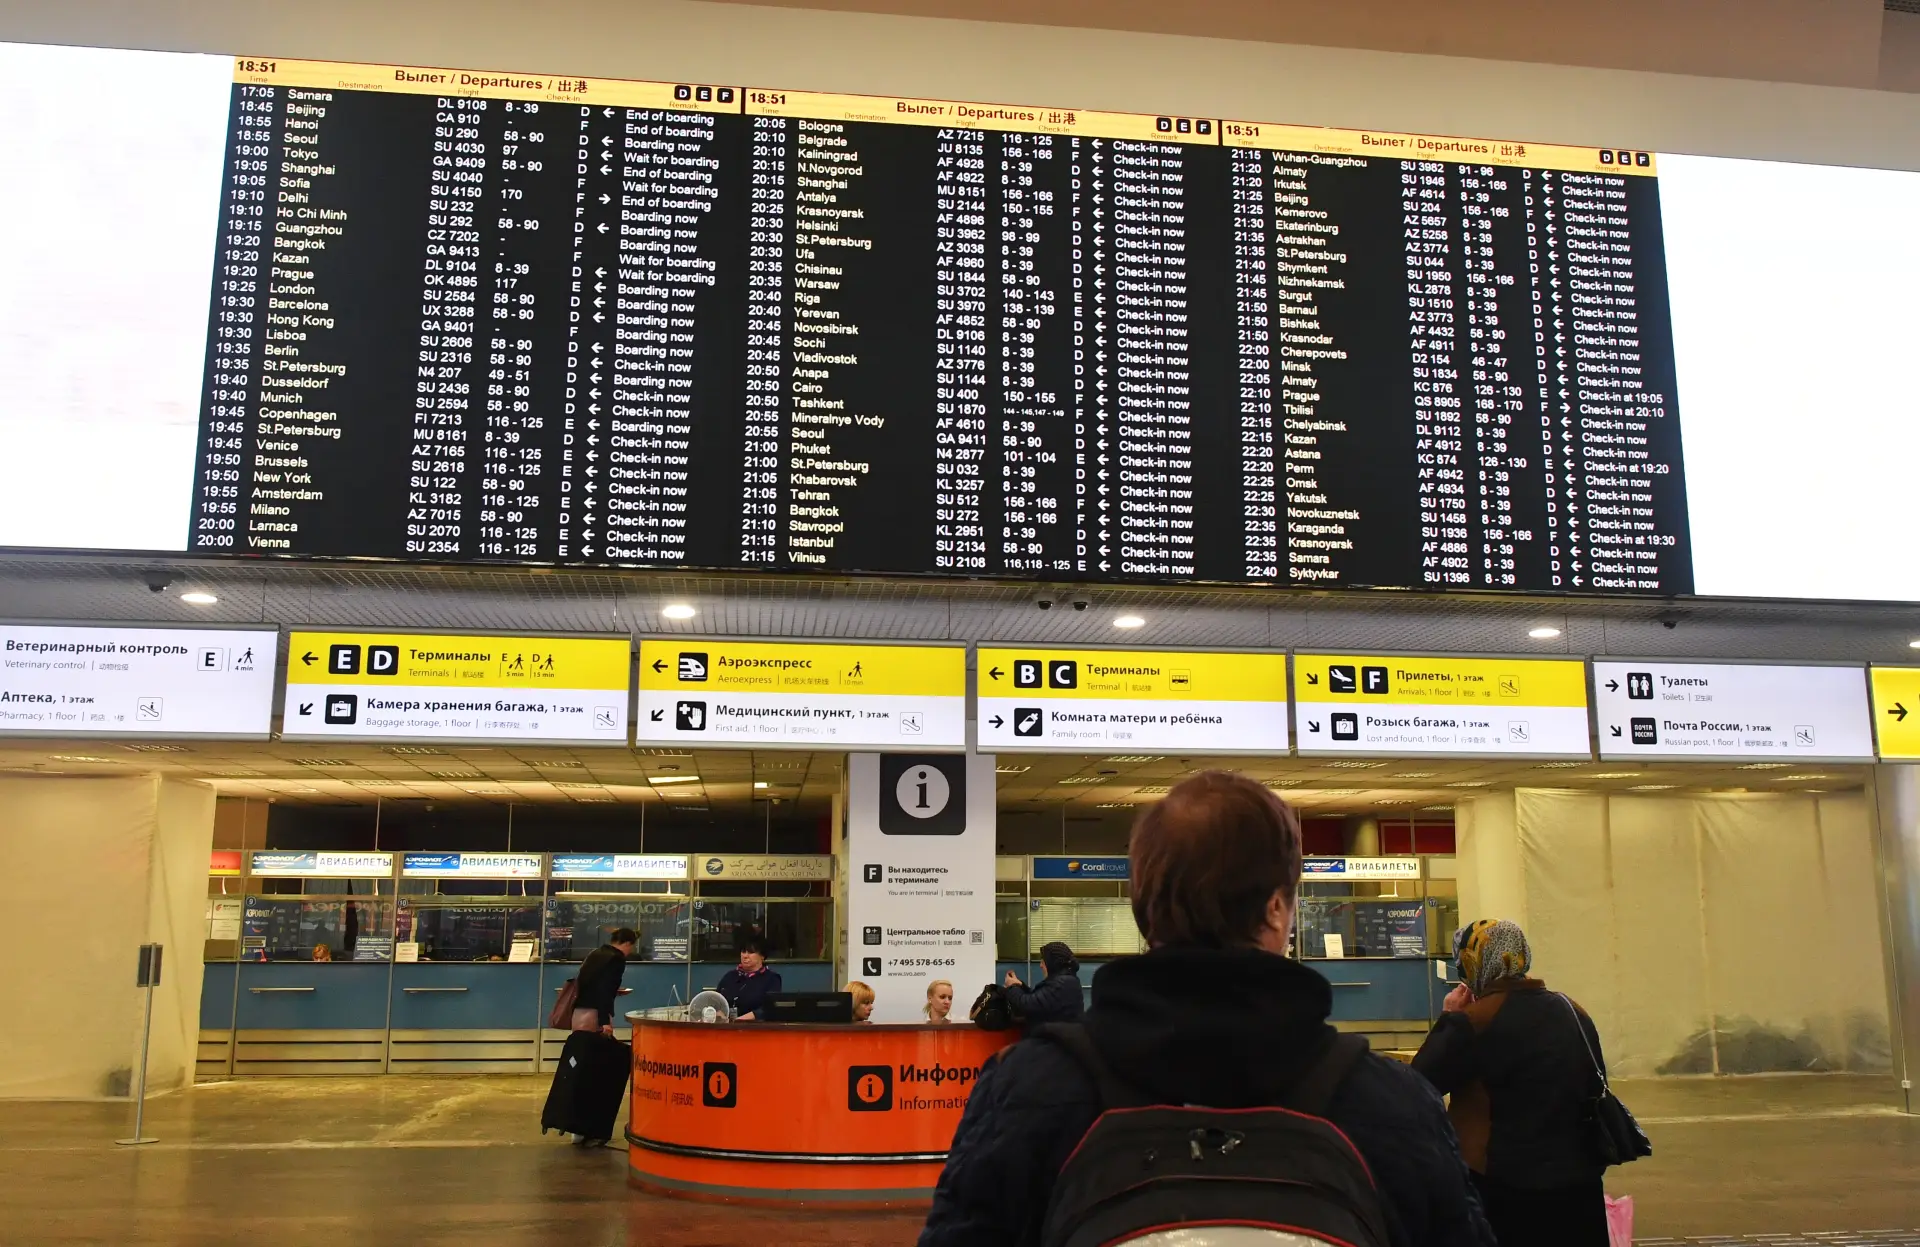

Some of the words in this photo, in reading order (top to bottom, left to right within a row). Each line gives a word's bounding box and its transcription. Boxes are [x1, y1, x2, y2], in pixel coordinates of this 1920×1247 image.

[237, 60, 276, 73] 18:51
[250, 75, 268, 83] Time
[337, 80, 383, 90] Destination
[395, 70, 446, 83] Вылет
[460, 74, 543, 89] Departures
[558, 79, 588, 94] 出港
[241, 86, 275, 98] 17:05
[288, 88, 333, 101] Samara
[750, 92, 786, 105] 18:51
[240, 101, 273, 113] 18:45
[286, 103, 326, 118] Beijing
[753, 117, 786, 129] 20:05
[798, 120, 844, 134] Bologna
[937, 129, 954, 140] AZ
[956, 130, 985, 142] 7215
[1417, 138, 1488, 153] Departures
[1231, 148, 1261, 160] 21:15
[1272, 151, 1367, 168] Wuhan-Guangzhou
[229, 204, 263, 216] 19:10
[276, 206, 294, 218] Ho
[297, 207, 317, 219] Chi
[320, 208, 347, 221] Minh
[750, 231, 783, 243] 20:30
[795, 233, 872, 250] St.Petersburg
[210, 405, 245, 417] 19:45
[259, 407, 337, 423] Copenhagen
[1240, 401, 1272, 414] 22:10
[1282, 403, 1314, 415] Tbilisi
[745, 410, 779, 422] 20:55
[791, 411, 852, 427] Mineralnye
[854, 414, 885, 429] Vody
[197, 534, 234, 547] 20:00
[248, 536, 290, 548] Vienna
[406, 540, 425, 552] SU
[427, 541, 460, 553] 2354
[605, 546, 658, 559] Check-in
[660, 550, 685, 559] now
[741, 550, 775, 562] 21:15
[788, 551, 826, 564] Vilnius
[1246, 565, 1278, 577] 22:40
[1289, 567, 1339, 581] Syktyvkar
[6, 639, 116, 655] Ветеринарный
[119, 645, 188, 657] контроль
[205, 652, 216, 667] E
[337, 649, 352, 669] E
[373, 650, 392, 670] D
[409, 649, 491, 663] Терминалы
[4, 659, 51, 671] Veterinary
[53, 661, 86, 670] control
[718, 656, 812, 671] Аэроэкспресс
[408, 668, 450, 677] Terminals
[1021, 664, 1035, 684] B
[1055, 665, 1070, 684] C
[1086, 664, 1160, 677] Терминалы
[1396, 670, 1454, 683] Прилеты,
[717, 674, 772, 685] Aeroexpress
[1369, 671, 1381, 689] F
[1660, 675, 1708, 688] Туалеты
[1086, 682, 1120, 691] Terminal
[1397, 687, 1427, 696] Arrivals,
[1434, 687, 1452, 696] floor
[0, 691, 56, 704] Аптека,
[1662, 693, 1685, 701] Toilets
[367, 698, 420, 712] Камера
[424, 702, 491, 713] хранения
[495, 700, 548, 714] багажа,
[716, 705, 810, 718] Медицинский
[813, 709, 855, 720] пункт,
[0, 711, 45, 722] Pharmacy,
[55, 711, 77, 721] floor
[366, 717, 405, 728] Baggage
[407, 719, 441, 729] storage,
[451, 719, 472, 728] floor
[1051, 711, 1106, 722] Комната
[1110, 715, 1156, 726] матери
[1159, 715, 1167, 723] и
[1170, 713, 1222, 726] ребёнка
[1366, 716, 1411, 727] Розыск
[1413, 716, 1459, 728] багажа,
[715, 723, 733, 732] First
[735, 724, 751, 734] aid,
[759, 724, 778, 733] floor
[1663, 720, 1698, 731] Почта
[1700, 721, 1743, 732] России,
[1051, 729, 1078, 740] Family
[1366, 734, 1382, 742] Lost
[1384, 735, 1399, 743] and
[1400, 734, 1425, 743] found,
[1432, 734, 1450, 743] floor
[1664, 738, 1692, 746] Russian
[1693, 739, 1711, 747] post,
[1717, 738, 1734, 746] floor
[318, 856, 393, 868] АВИАБИЛЕТЫ
[460, 856, 541, 868] АВИАБИЛЕТЫ
[615, 859, 687, 870] АВИАБИЛЕТЫ
[1348, 862, 1417, 871] АВИАБИЛЕТЫ
[869, 867, 877, 880] F
[888, 866, 901, 874] Вы
[894, 877, 939, 885] терминале
[886, 928, 941, 937] Центральное
[942, 927, 966, 935] табло
[887, 939, 904, 947] Flight
[916, 958, 955, 966] 578-65-65
[900, 1062, 982, 1087] Инфор
